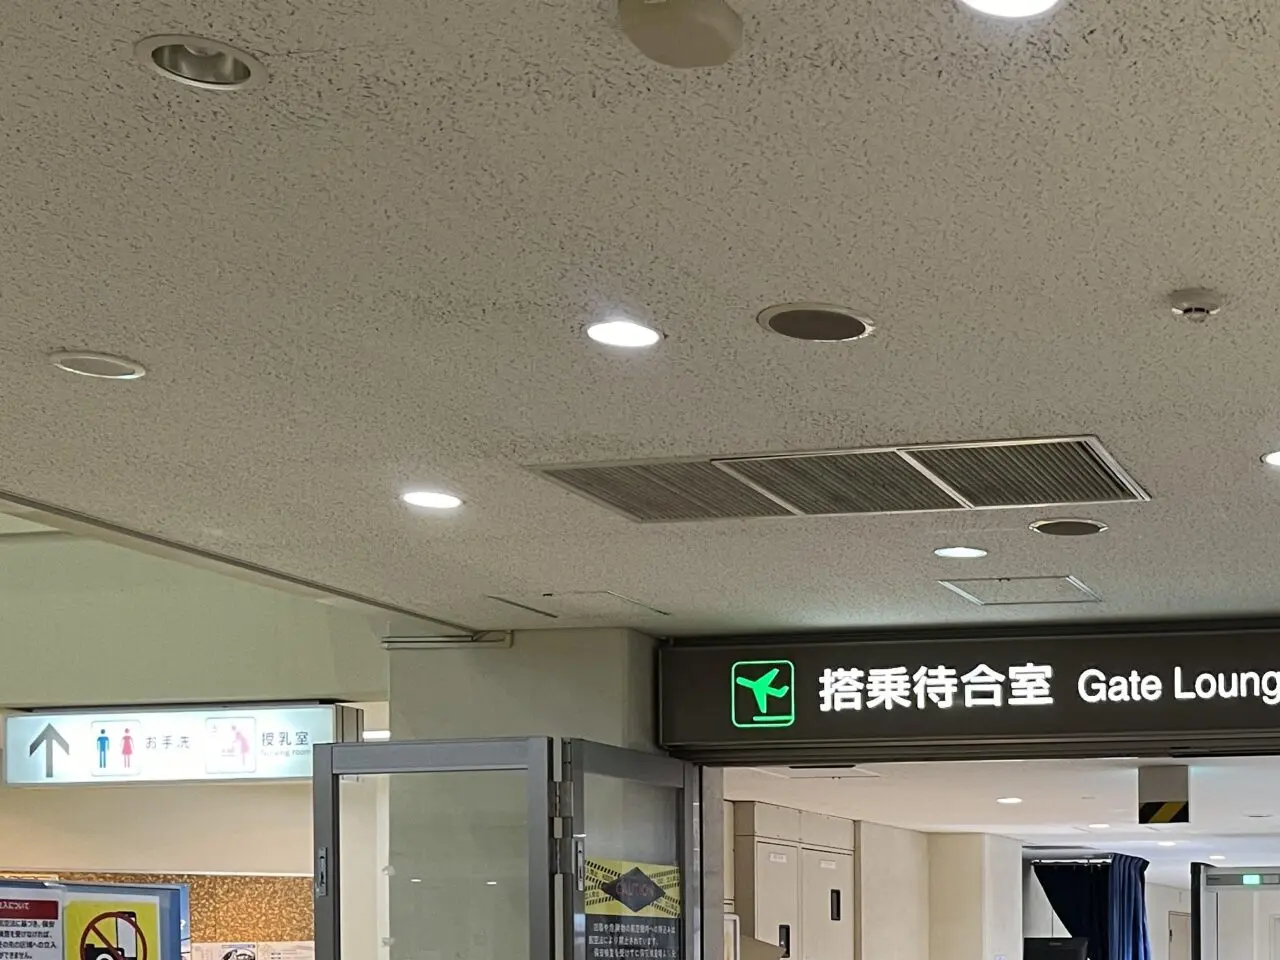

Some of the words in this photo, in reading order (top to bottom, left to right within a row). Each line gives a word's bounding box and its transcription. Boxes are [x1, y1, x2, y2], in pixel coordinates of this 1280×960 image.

[818, 662, 1054, 711] 搭乗待合室
[1077, 668, 1163, 704] Gate
[262, 731, 309, 747] 授乳室
